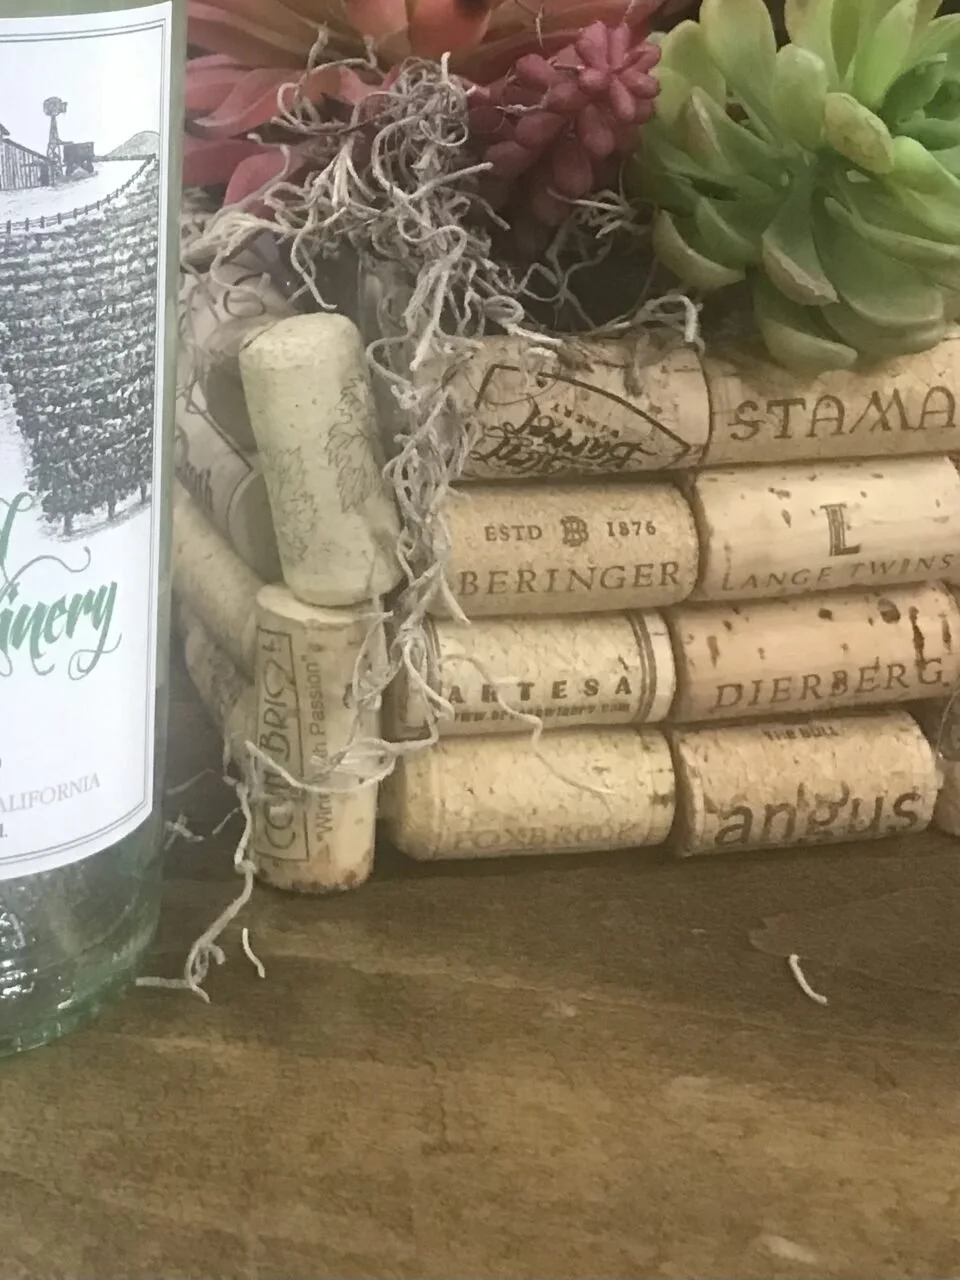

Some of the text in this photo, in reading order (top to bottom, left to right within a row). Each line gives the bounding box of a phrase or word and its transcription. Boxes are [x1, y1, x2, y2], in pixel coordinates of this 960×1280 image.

[484, 524, 543, 543] ESTD
[606, 520, 657, 538] 1876
[819, 502, 862, 557] L
[457, 560, 680, 597] BERINGER
[722, 553, 955, 592] LANGE TWINS
[448, 675, 632, 705] ARTESA
[714, 782, 921, 846] angus
